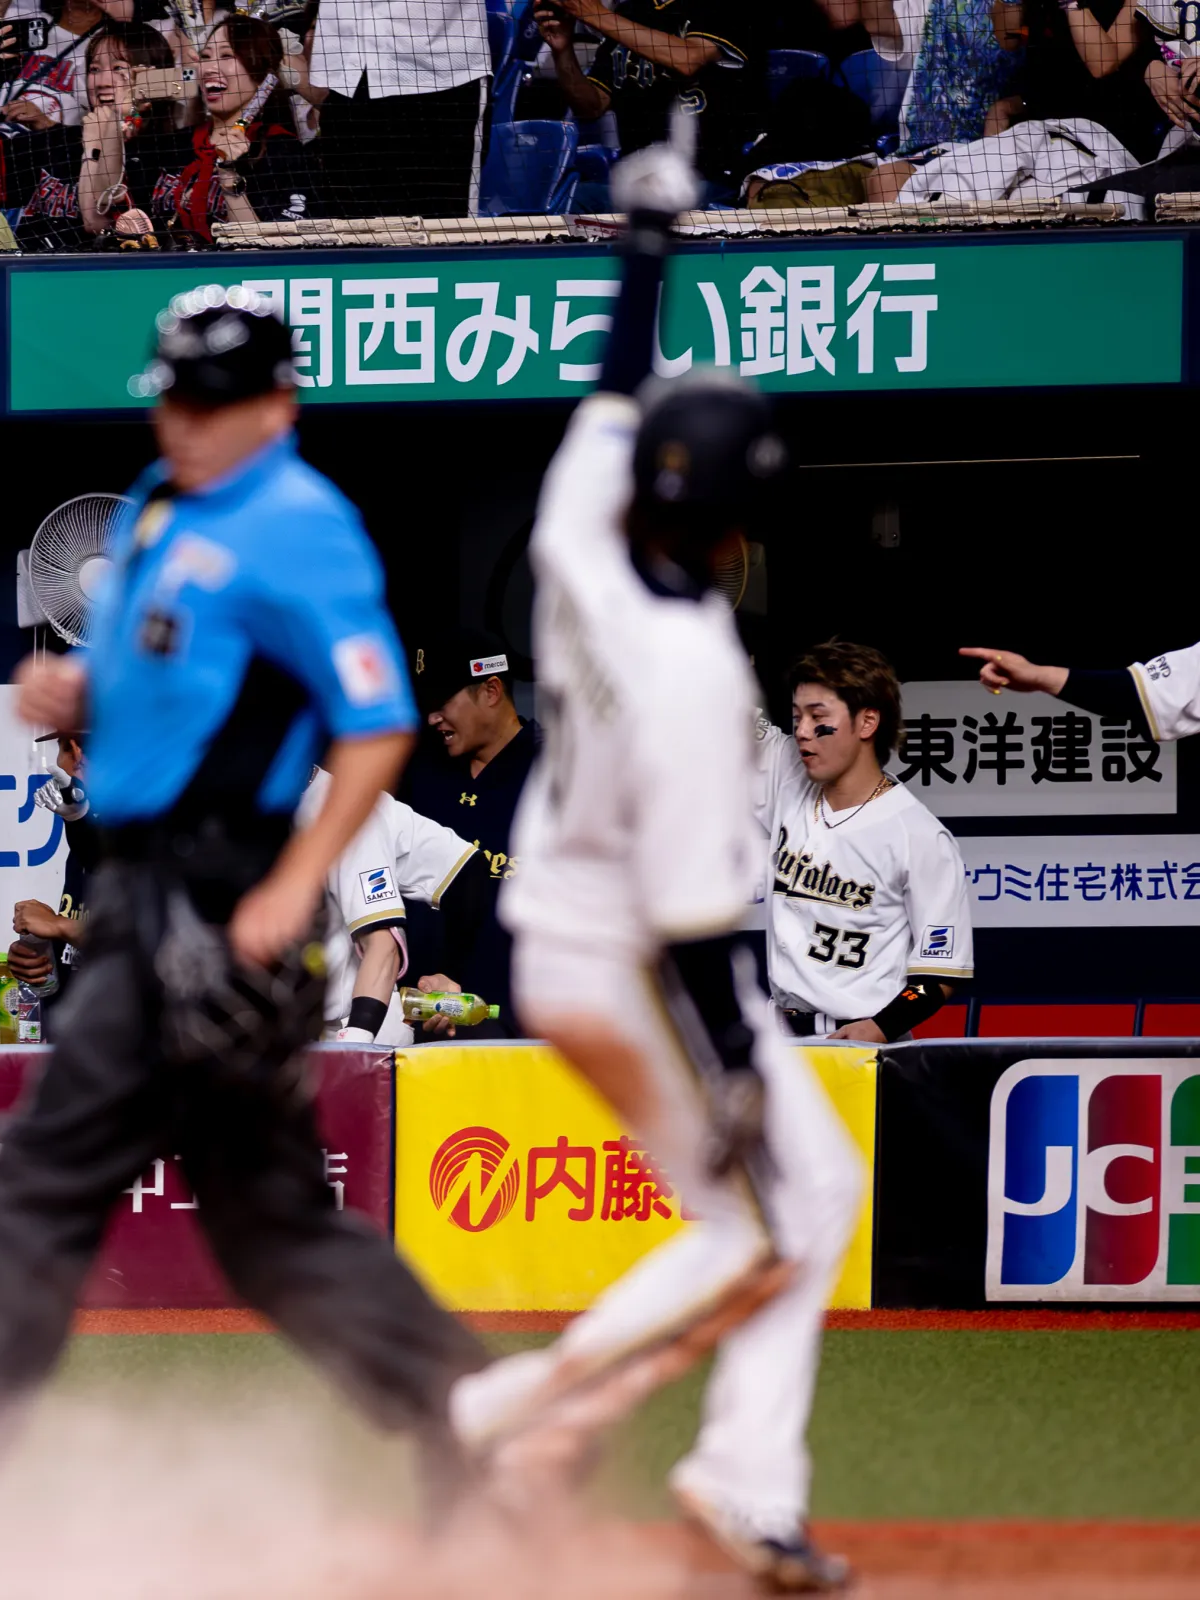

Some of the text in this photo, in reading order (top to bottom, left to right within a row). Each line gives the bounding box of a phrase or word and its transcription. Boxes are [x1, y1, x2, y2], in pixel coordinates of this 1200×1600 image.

[876, 711, 1163, 786] 東洋建設
[366, 889, 395, 902] SAMTY
[807, 921, 872, 971] 33
[922, 949, 953, 957] SAMTY
